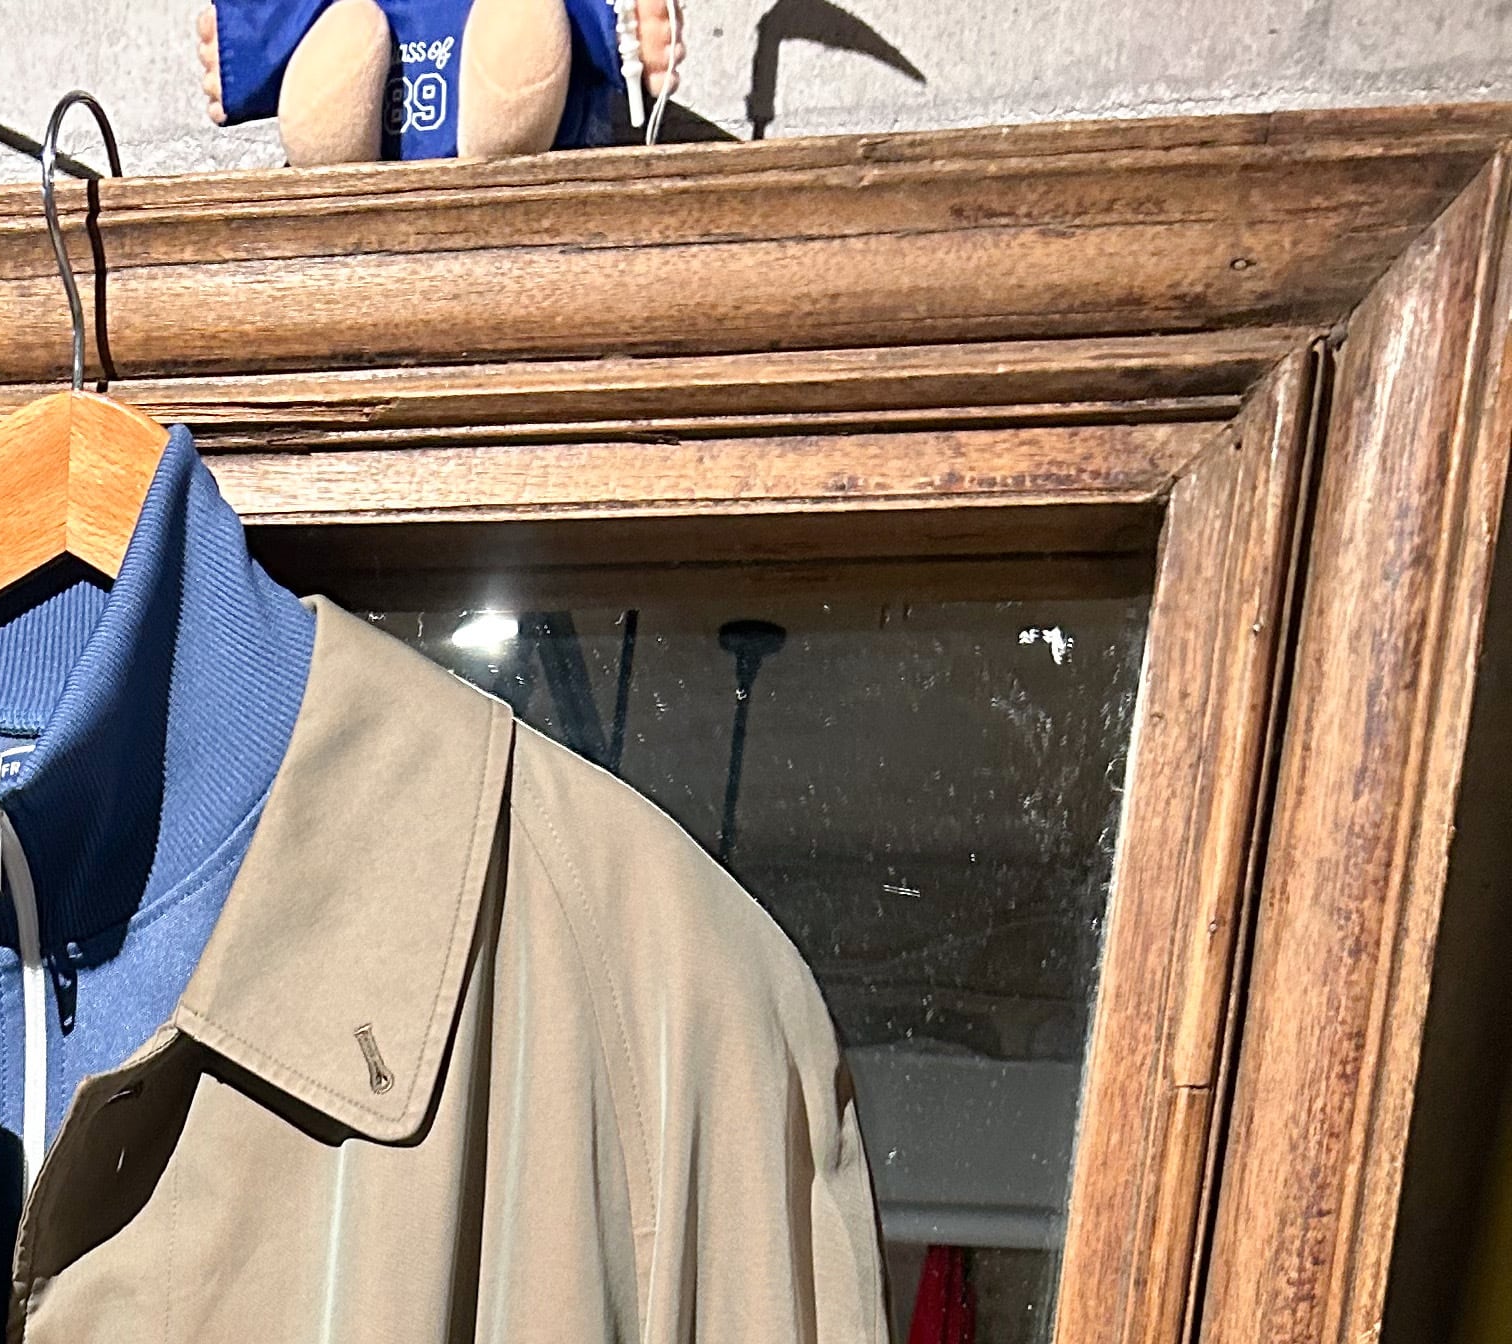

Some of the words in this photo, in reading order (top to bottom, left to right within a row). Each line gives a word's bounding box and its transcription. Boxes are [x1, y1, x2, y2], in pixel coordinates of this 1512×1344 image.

[428, 36, 455, 70] of
[384, 72, 447, 135] 89
[1, 761, 21, 778] FR
